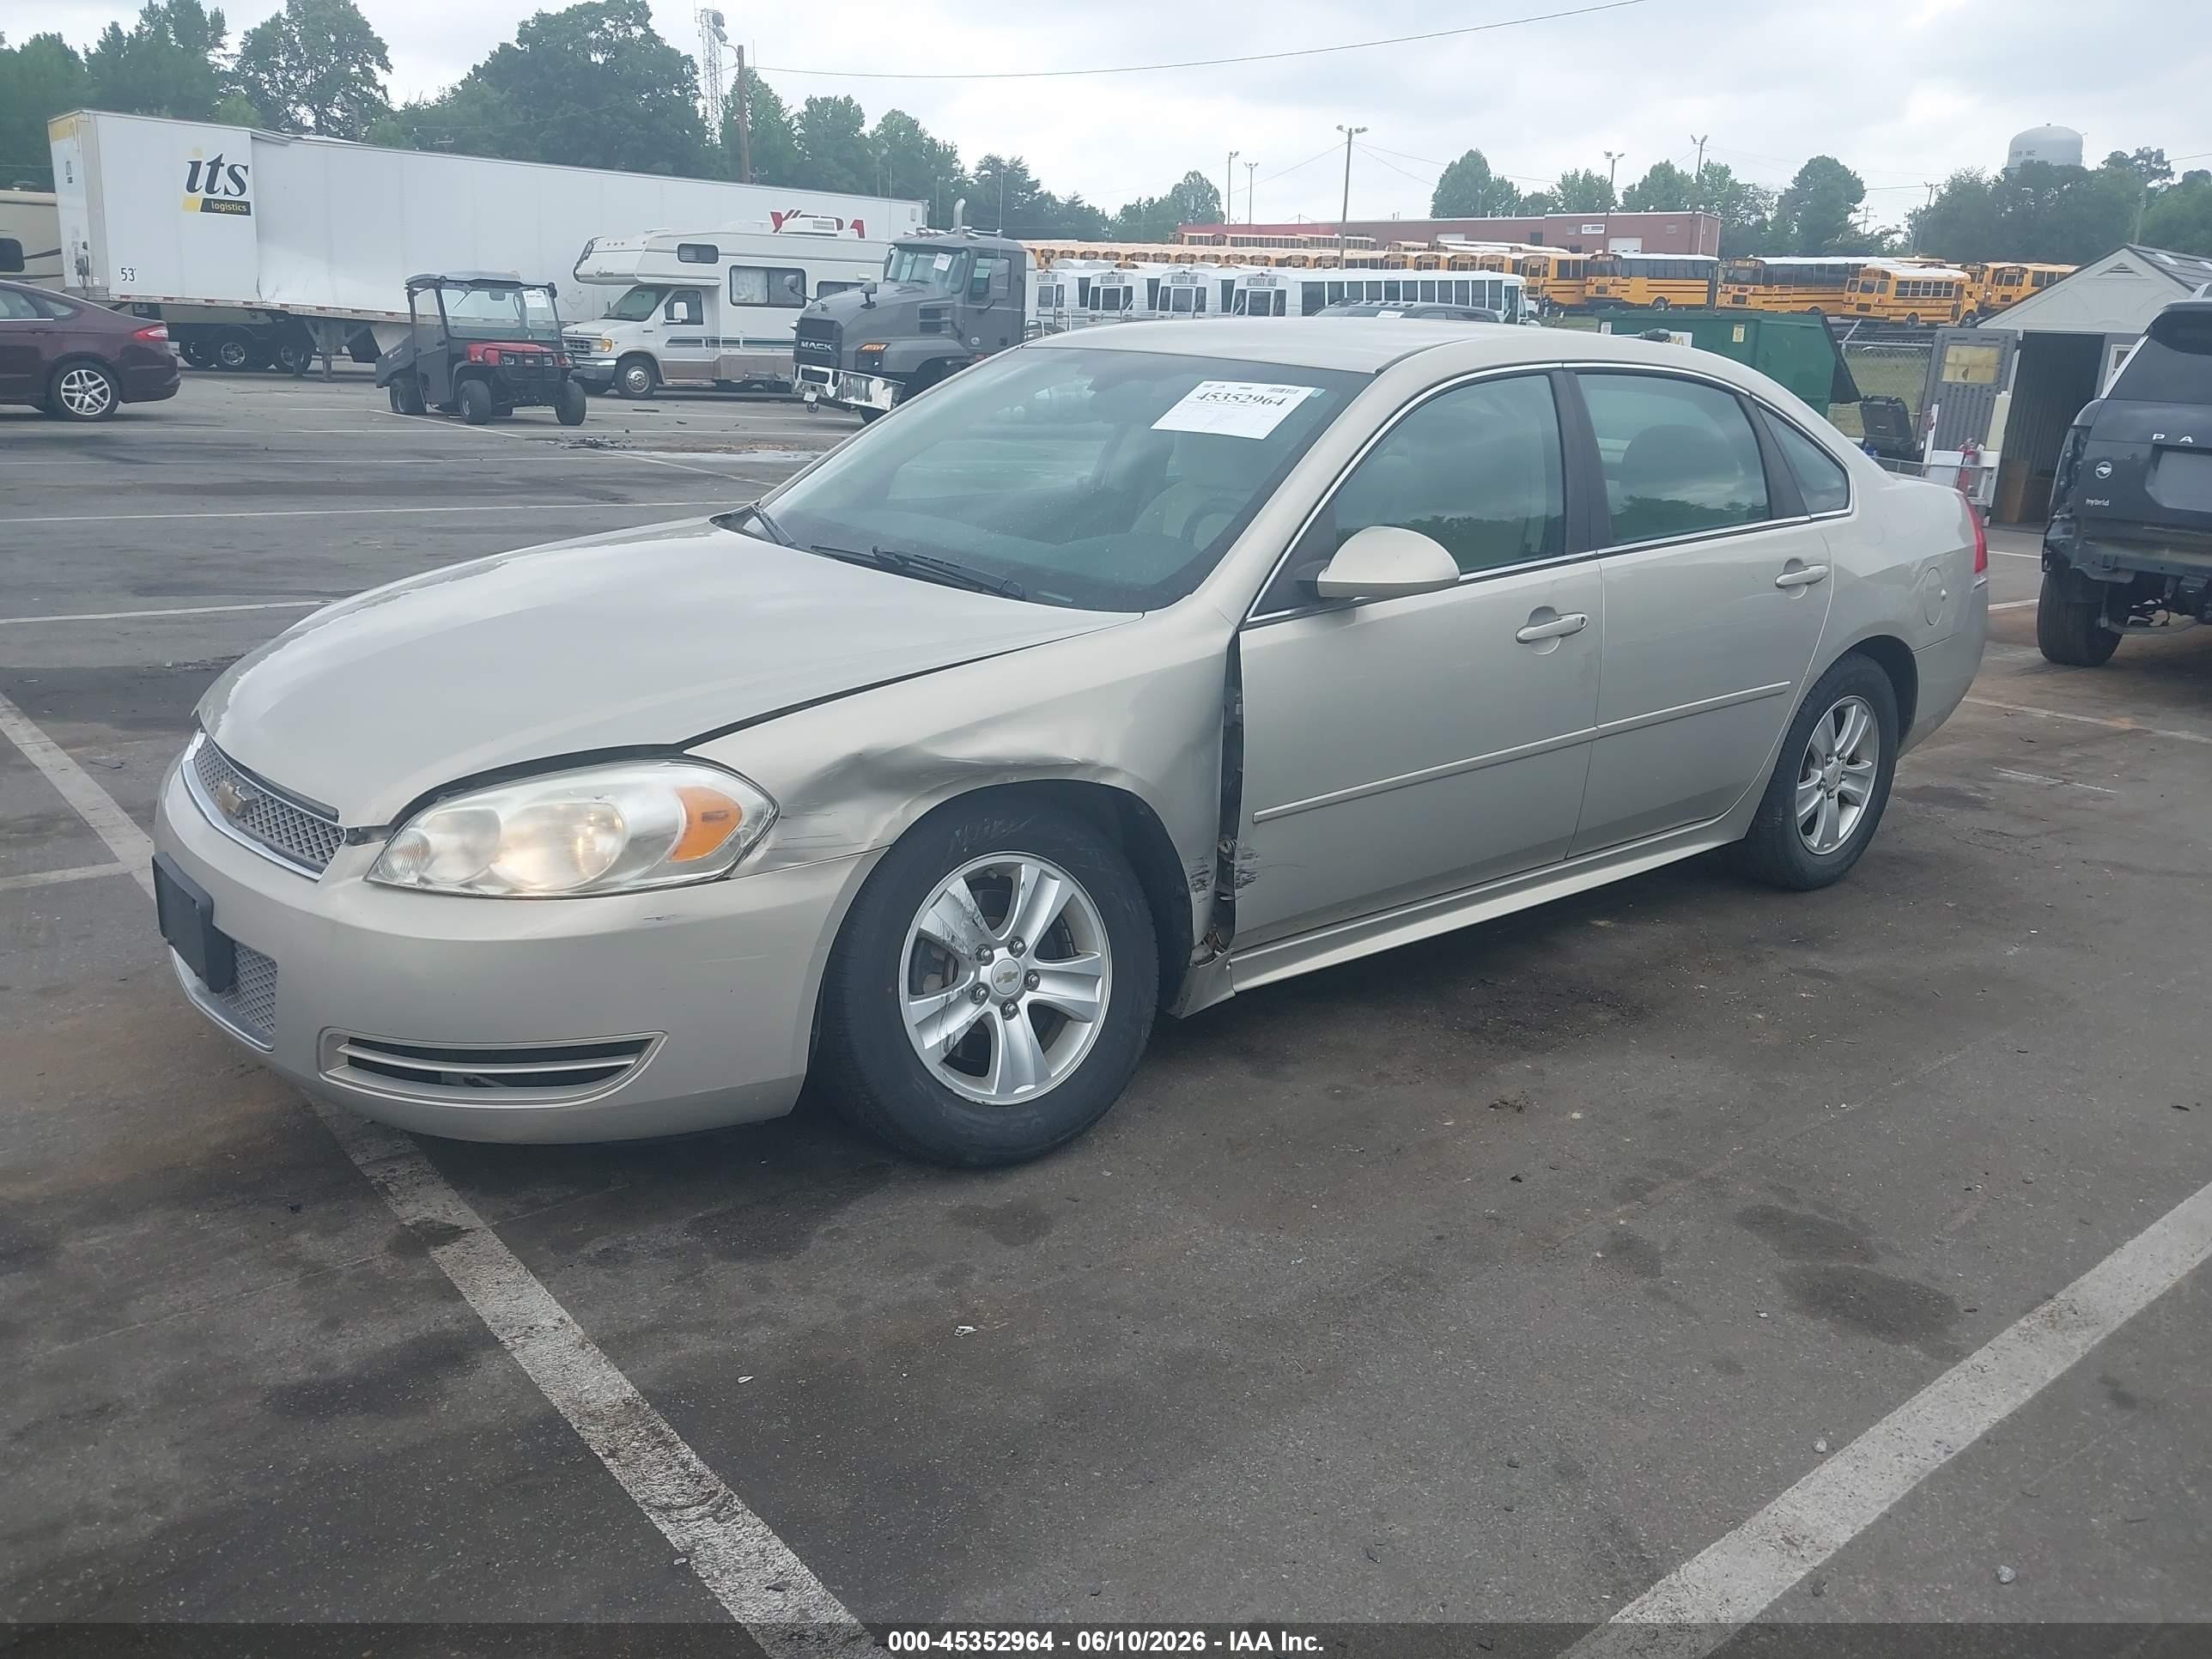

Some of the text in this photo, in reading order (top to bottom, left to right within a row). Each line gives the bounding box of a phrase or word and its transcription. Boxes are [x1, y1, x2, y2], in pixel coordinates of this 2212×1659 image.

[185, 147, 249, 197] its
[211, 201, 247, 212] logistics
[800, 341, 832, 351] MACK
[1196, 392, 1288, 406] 45352964
[2085, 497, 2110, 507] hybrid
